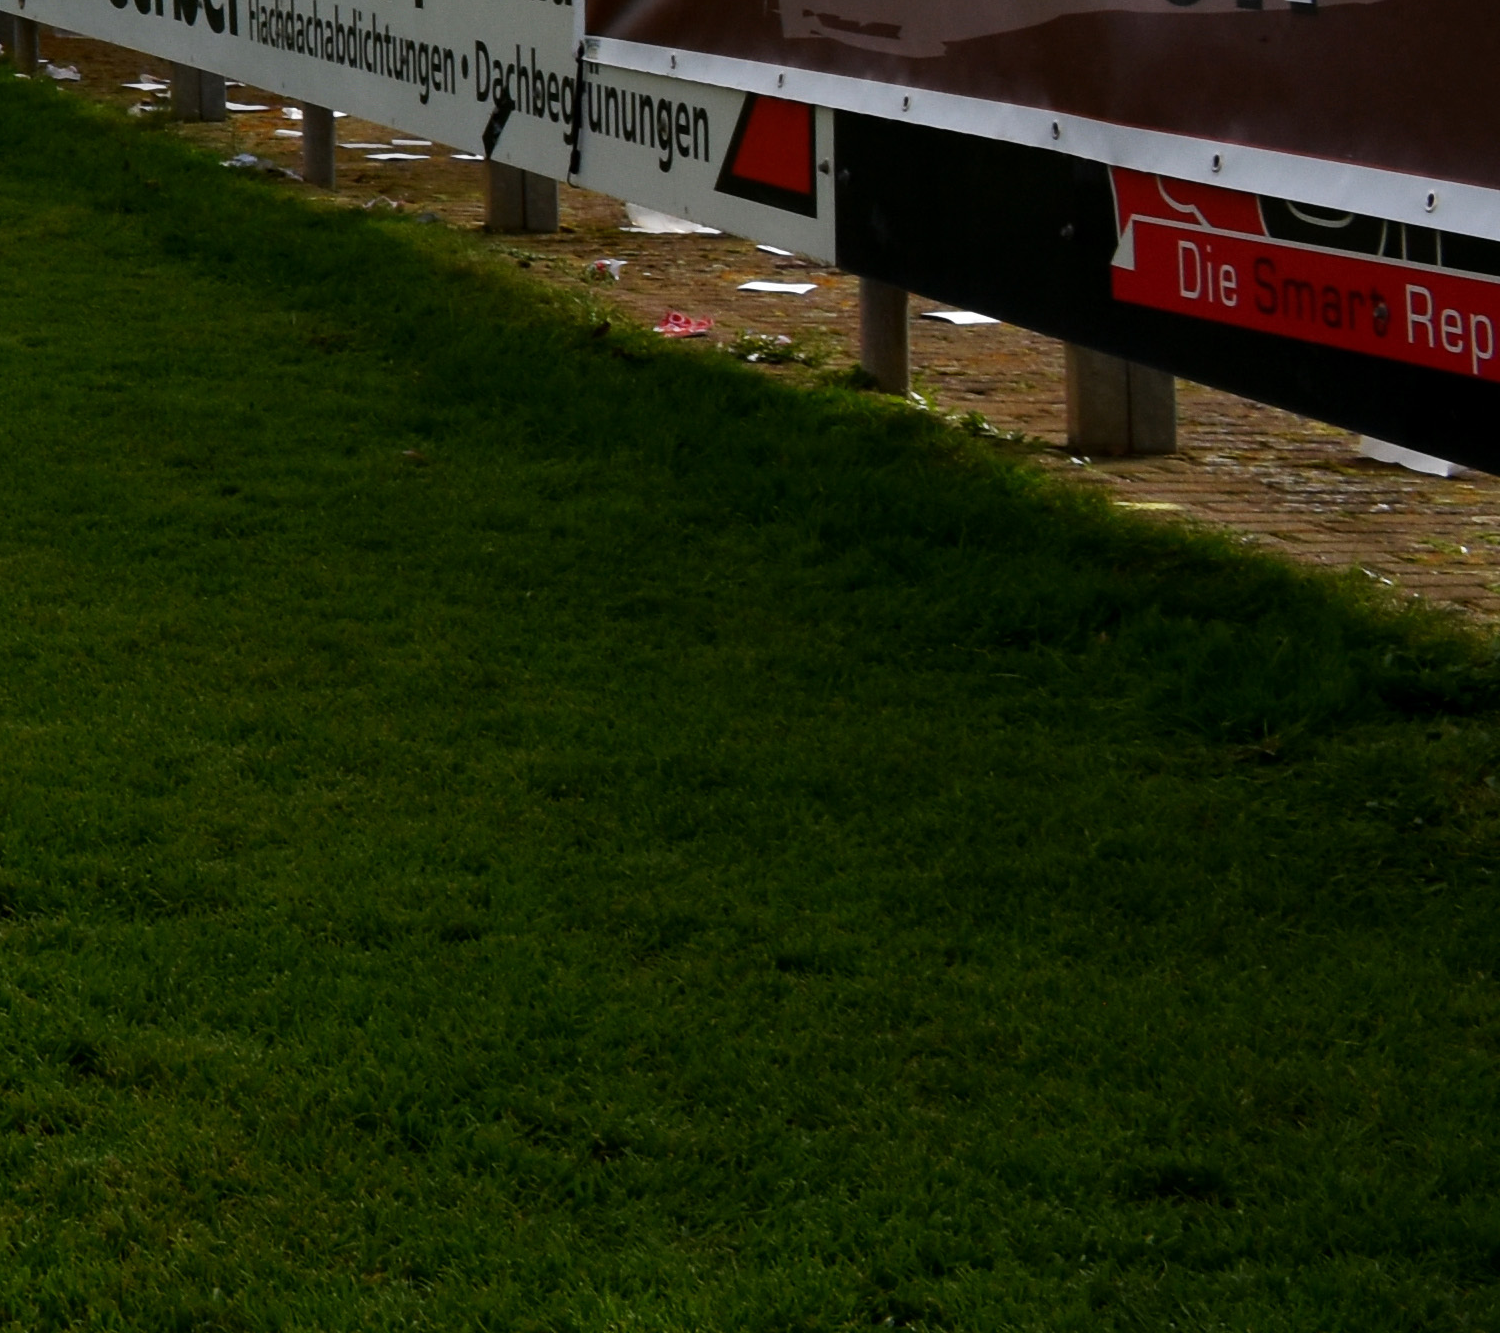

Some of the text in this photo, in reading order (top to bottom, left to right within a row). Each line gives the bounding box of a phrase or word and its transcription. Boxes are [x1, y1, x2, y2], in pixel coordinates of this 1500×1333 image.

[475, 39, 710, 173] Dachbegünungen
[1178, 239, 1494, 375] Die Smart Rep
